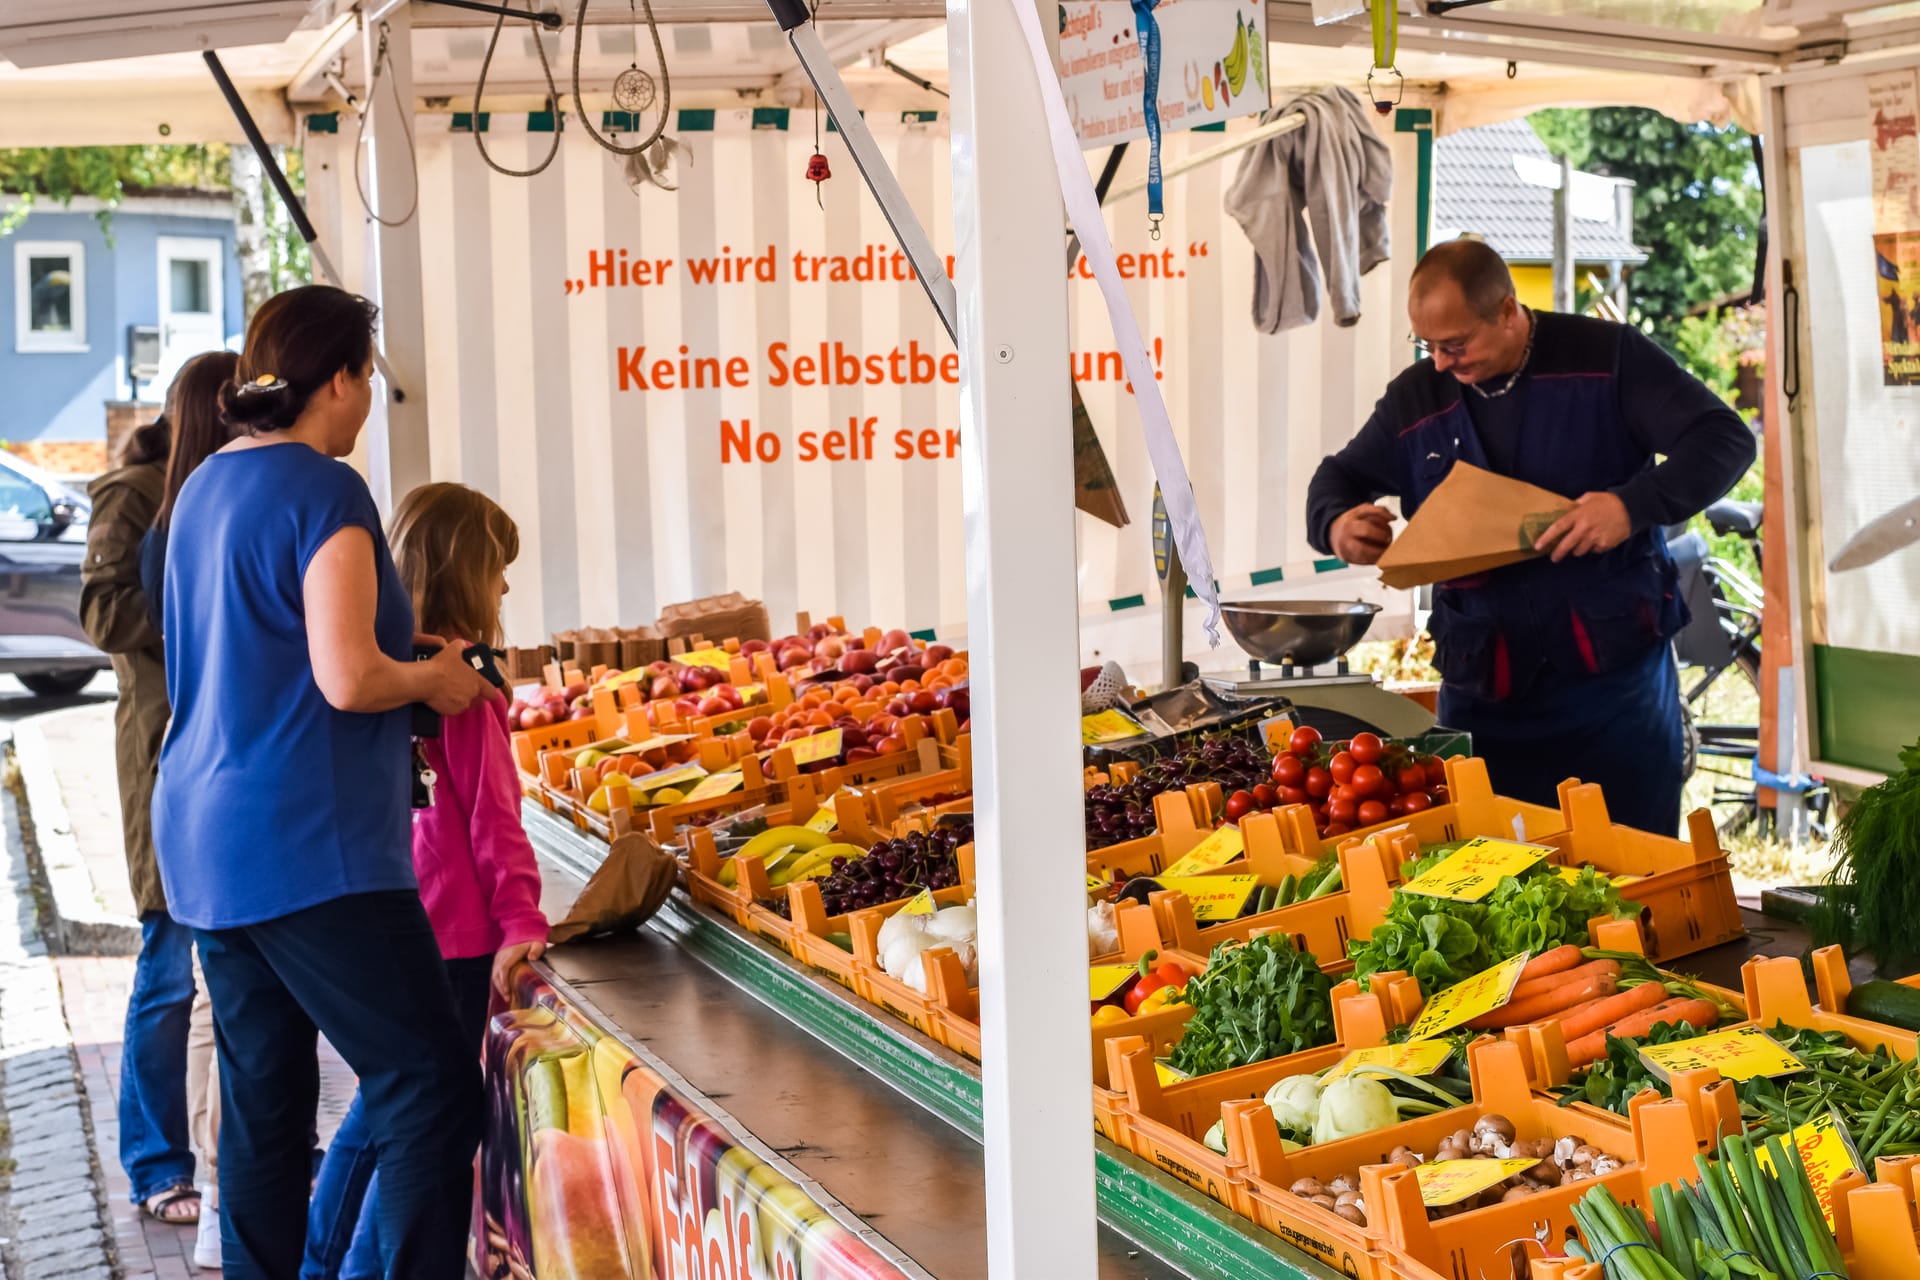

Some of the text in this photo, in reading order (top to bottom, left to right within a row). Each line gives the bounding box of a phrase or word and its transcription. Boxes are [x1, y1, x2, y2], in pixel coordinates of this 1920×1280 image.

[687, 246, 777, 285] wird
[616, 344, 750, 391] Keine
[719, 417, 958, 464] No self ser
